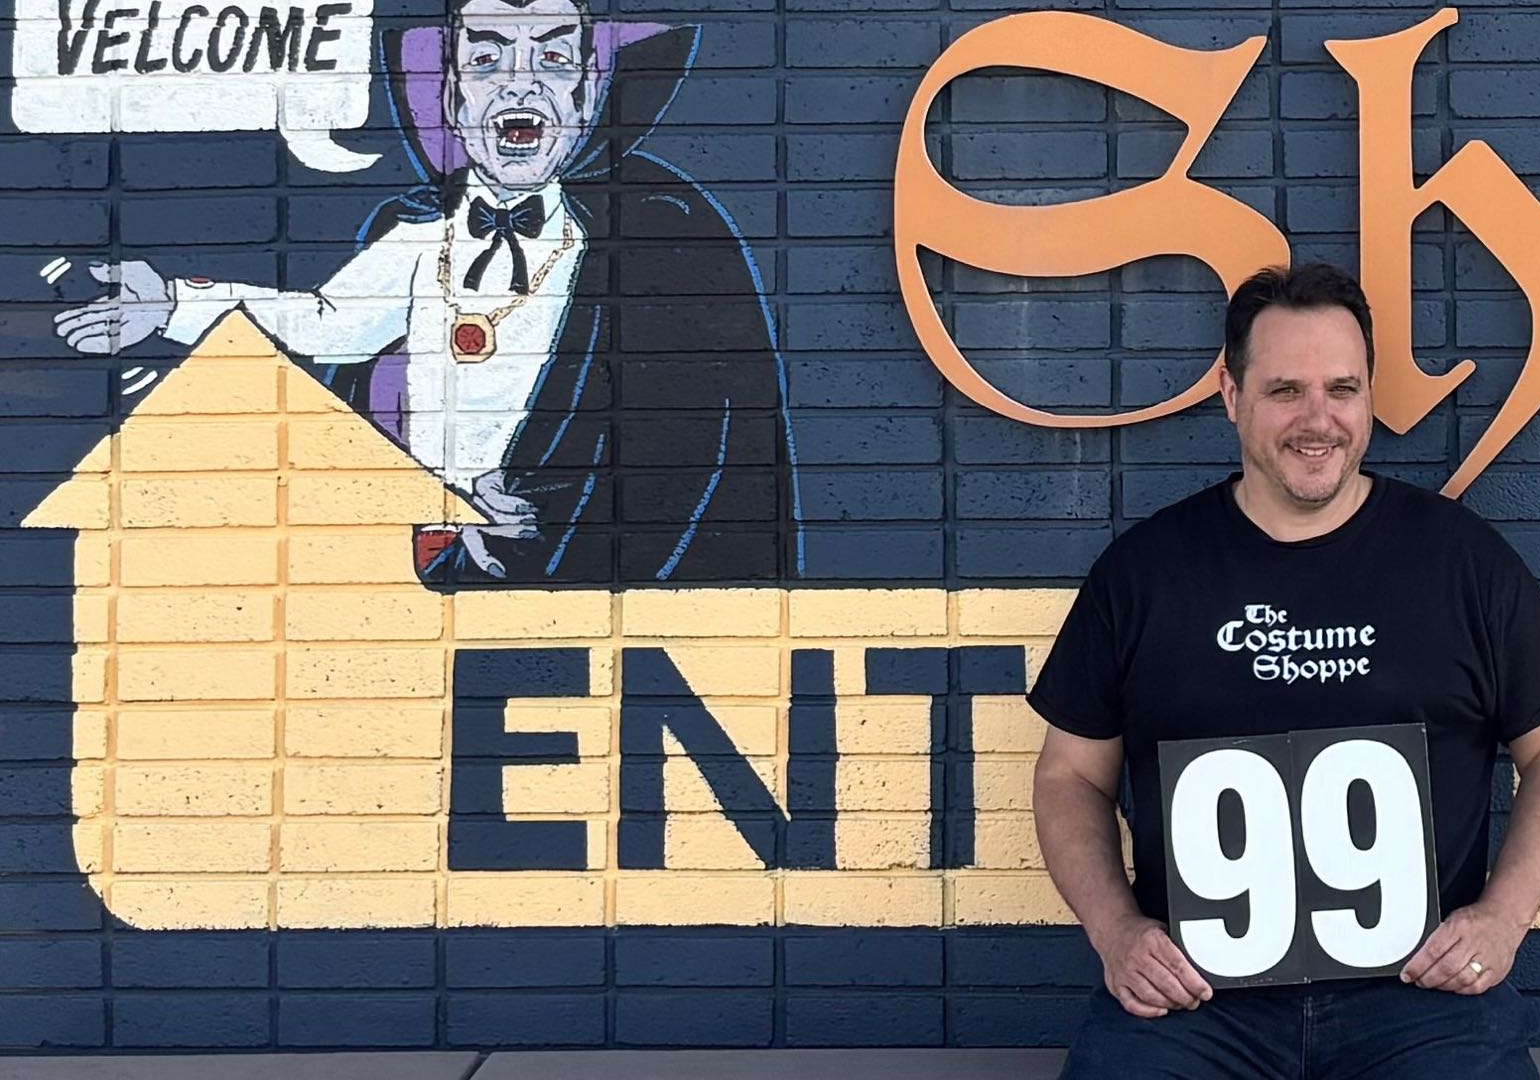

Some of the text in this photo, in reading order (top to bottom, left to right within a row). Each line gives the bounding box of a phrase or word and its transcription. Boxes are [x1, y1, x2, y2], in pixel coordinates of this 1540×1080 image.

[1244, 604, 1288, 627] The
[1216, 620, 1376, 652] Costume
[1253, 654, 1371, 685] Shoppe
[1171, 739, 1429, 978] 99
